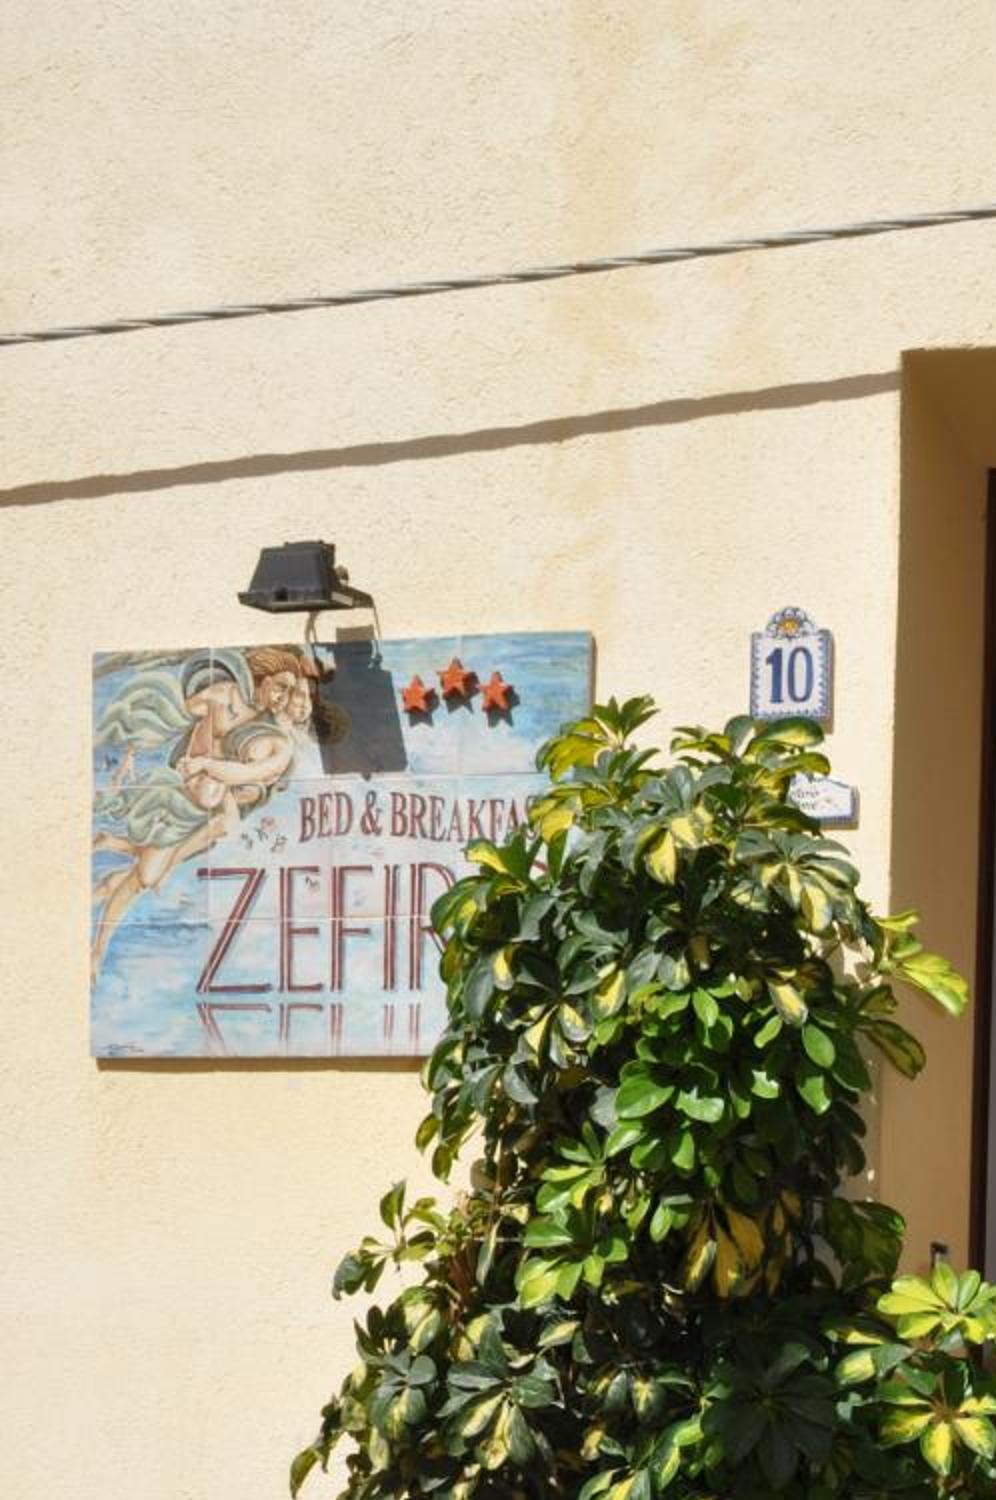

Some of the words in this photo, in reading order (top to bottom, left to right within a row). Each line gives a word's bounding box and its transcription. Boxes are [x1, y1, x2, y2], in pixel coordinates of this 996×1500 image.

[765, 645, 814, 705] 10
[299, 791, 354, 843] BED
[360, 789, 384, 836] &
